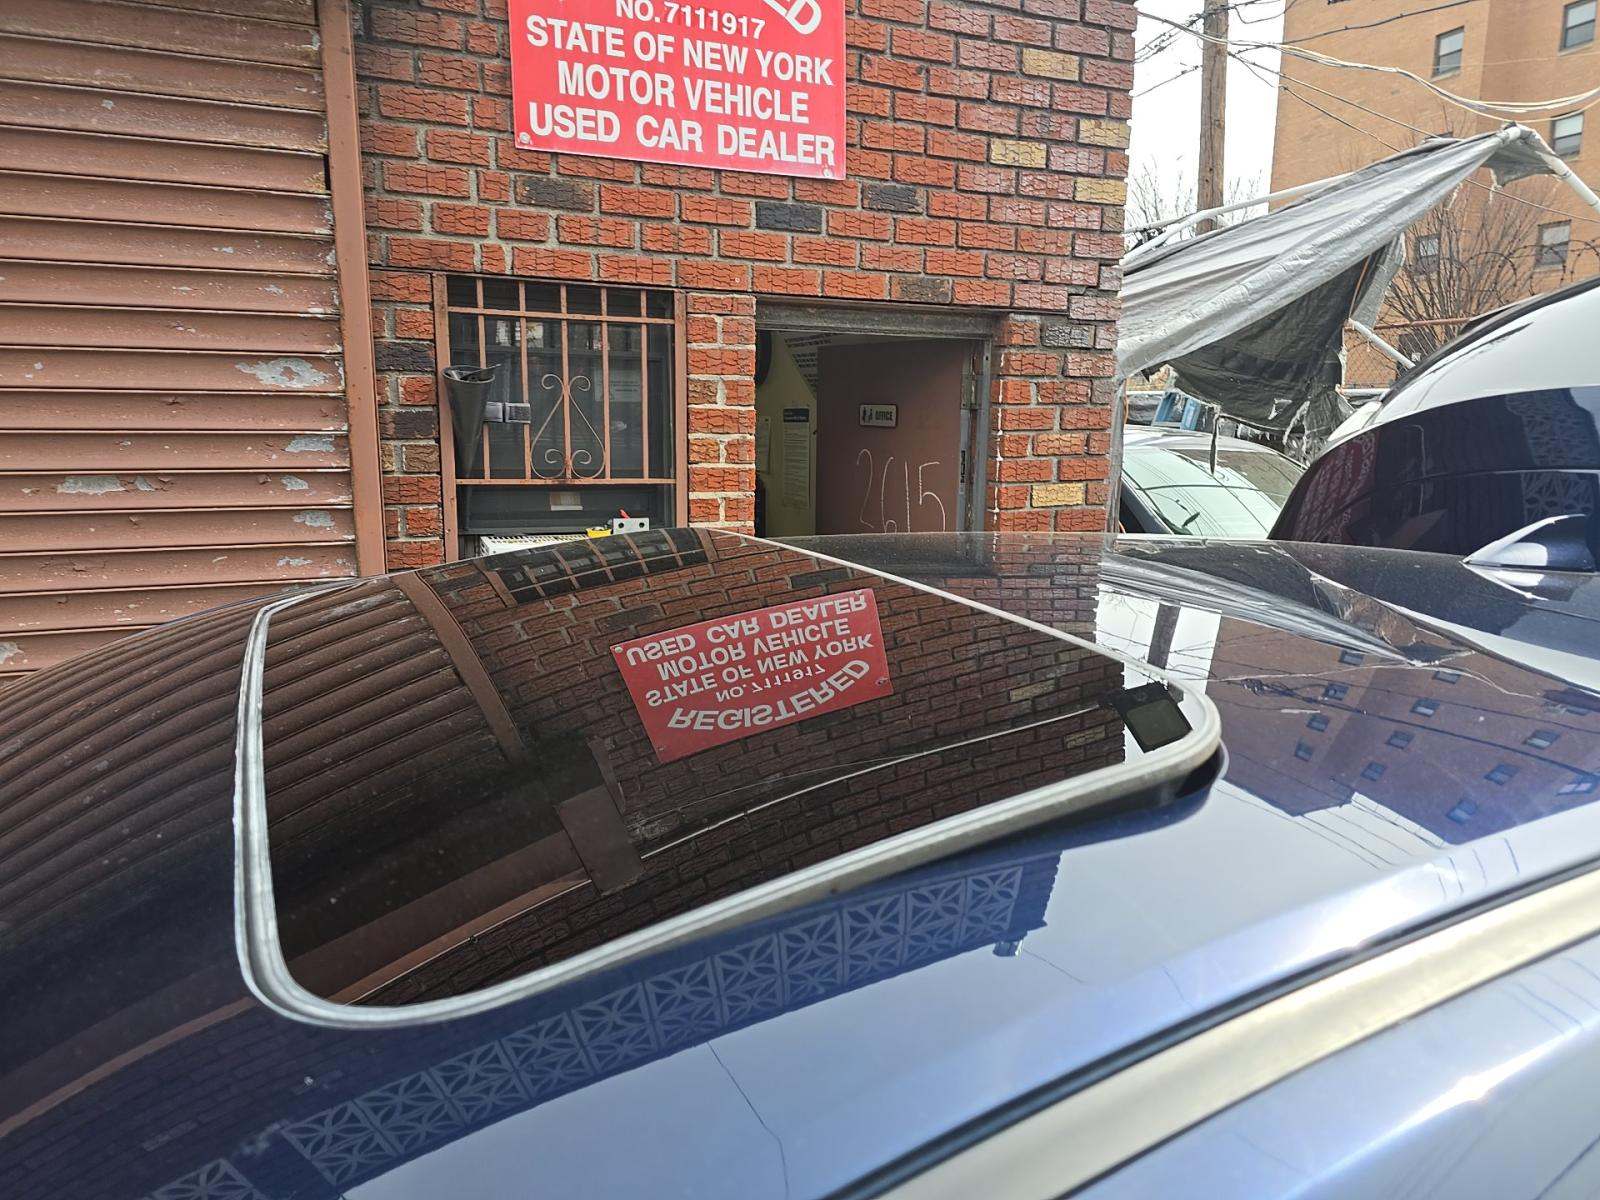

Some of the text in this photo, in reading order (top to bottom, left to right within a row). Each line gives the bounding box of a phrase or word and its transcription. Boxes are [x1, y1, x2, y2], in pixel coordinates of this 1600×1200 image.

[526, 15, 834, 86] STATE OF NEW YORK
[558, 60, 809, 124] MOTOR VEHICLE
[529, 102, 835, 166] USED CAR DEALER
